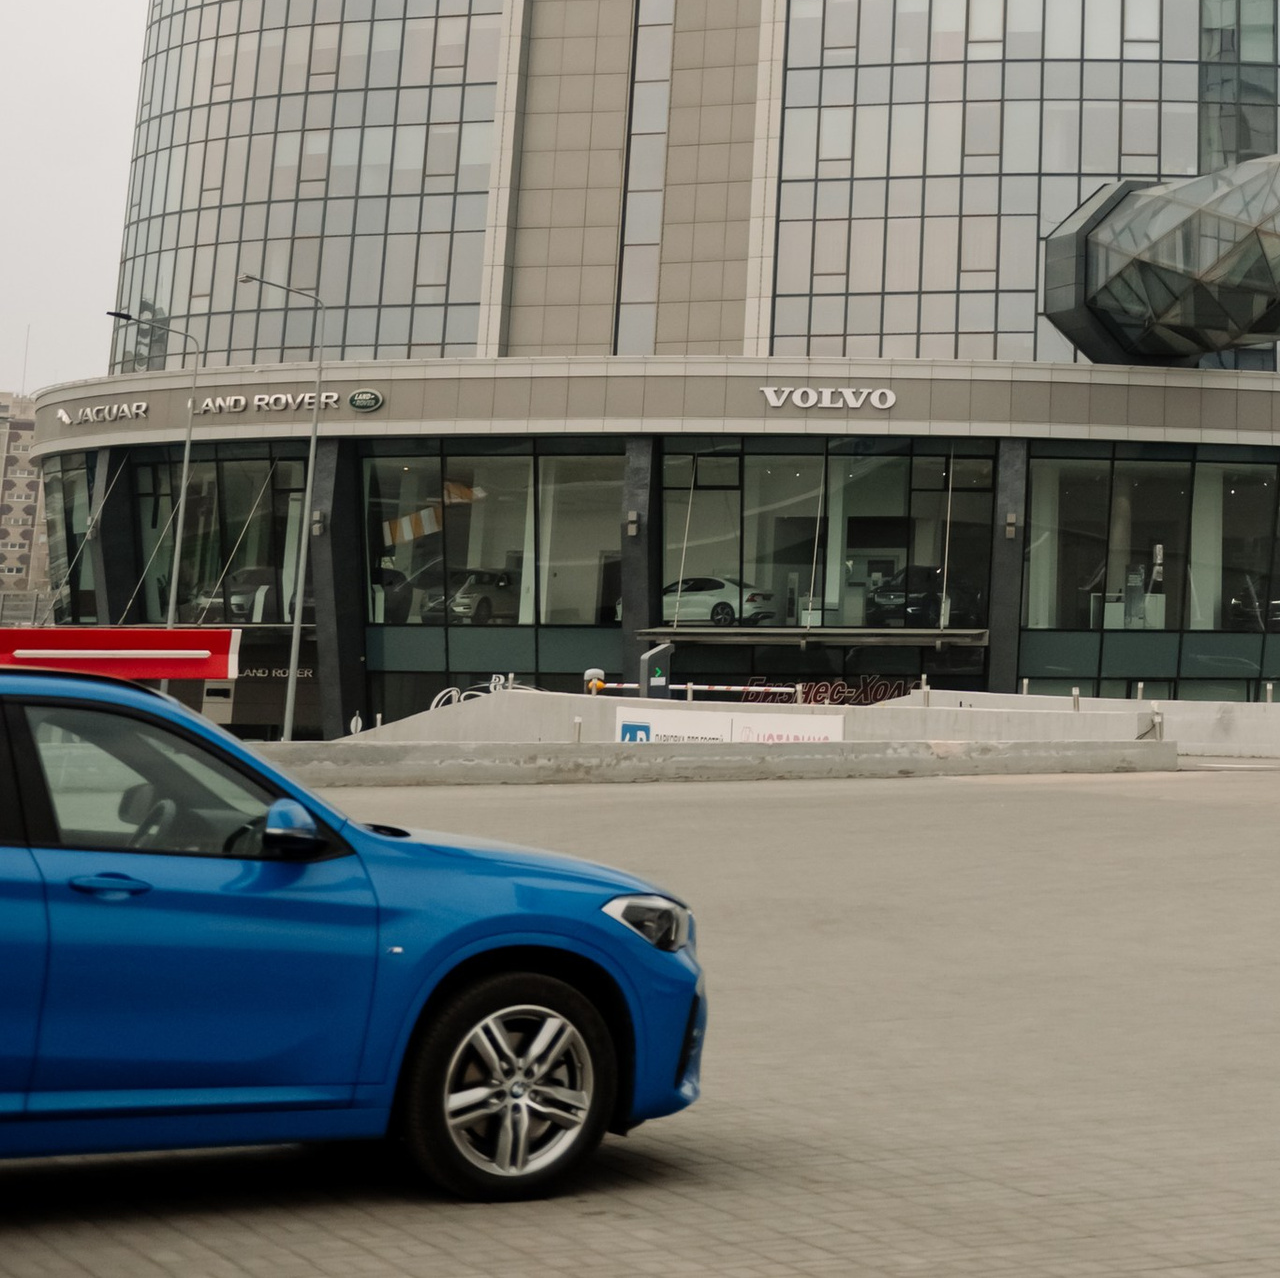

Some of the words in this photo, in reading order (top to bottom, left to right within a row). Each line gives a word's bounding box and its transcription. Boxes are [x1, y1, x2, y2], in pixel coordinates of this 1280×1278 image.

[187, 395, 247, 414] LAND
[253, 392, 340, 411] ROVER
[759, 387, 897, 409] VOLVO
[75, 402, 149, 424] JAGUAR
[272, 668, 313, 677] ROER
